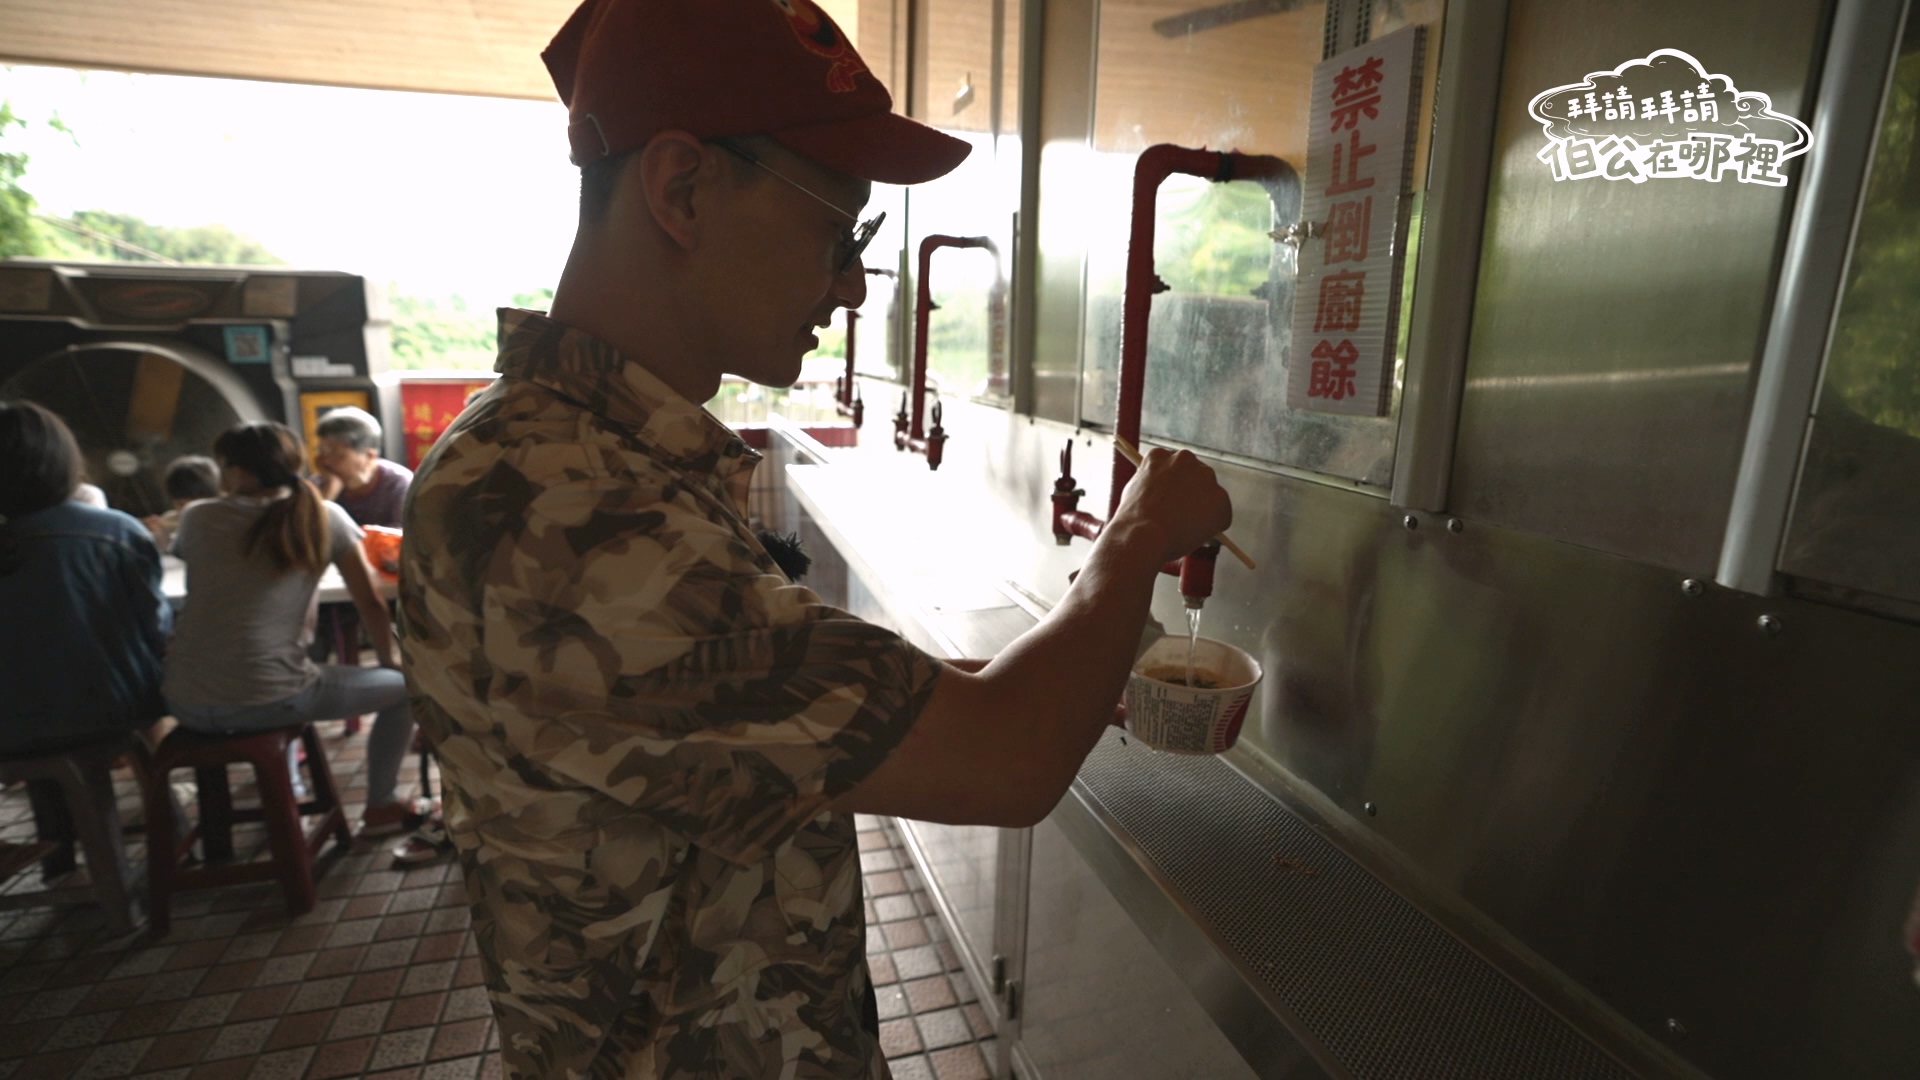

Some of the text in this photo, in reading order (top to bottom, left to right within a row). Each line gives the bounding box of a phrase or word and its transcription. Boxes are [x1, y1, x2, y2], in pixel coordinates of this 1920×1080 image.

[1307, 56, 1384, 400] 禁止倒廚餘
